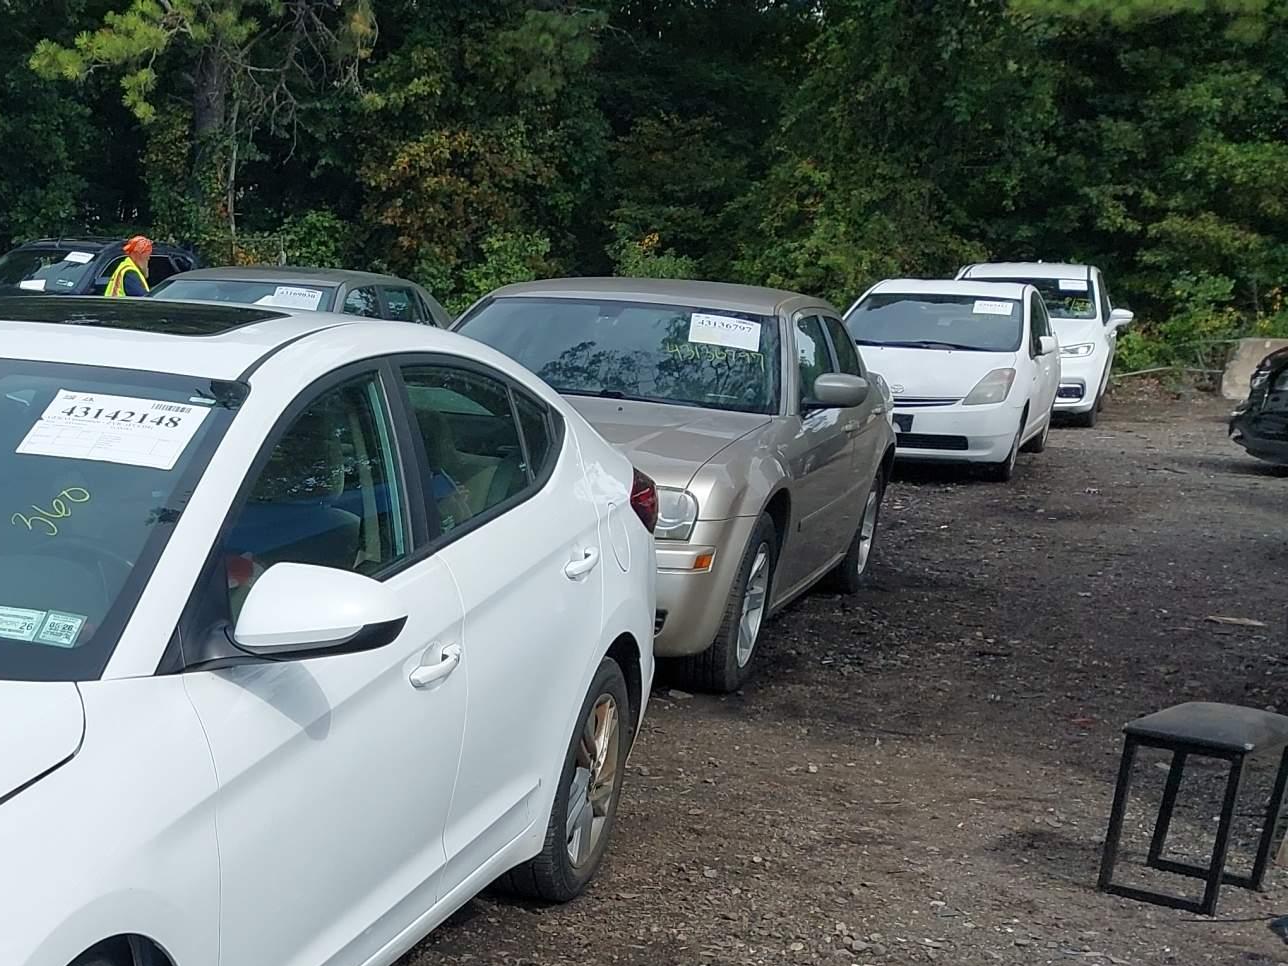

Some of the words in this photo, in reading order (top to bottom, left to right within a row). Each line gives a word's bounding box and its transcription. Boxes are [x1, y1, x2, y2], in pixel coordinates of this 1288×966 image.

[697, 319, 753, 334] 43136797
[61, 405, 183, 429] 43142148
[11, 487, 90, 536] 360
